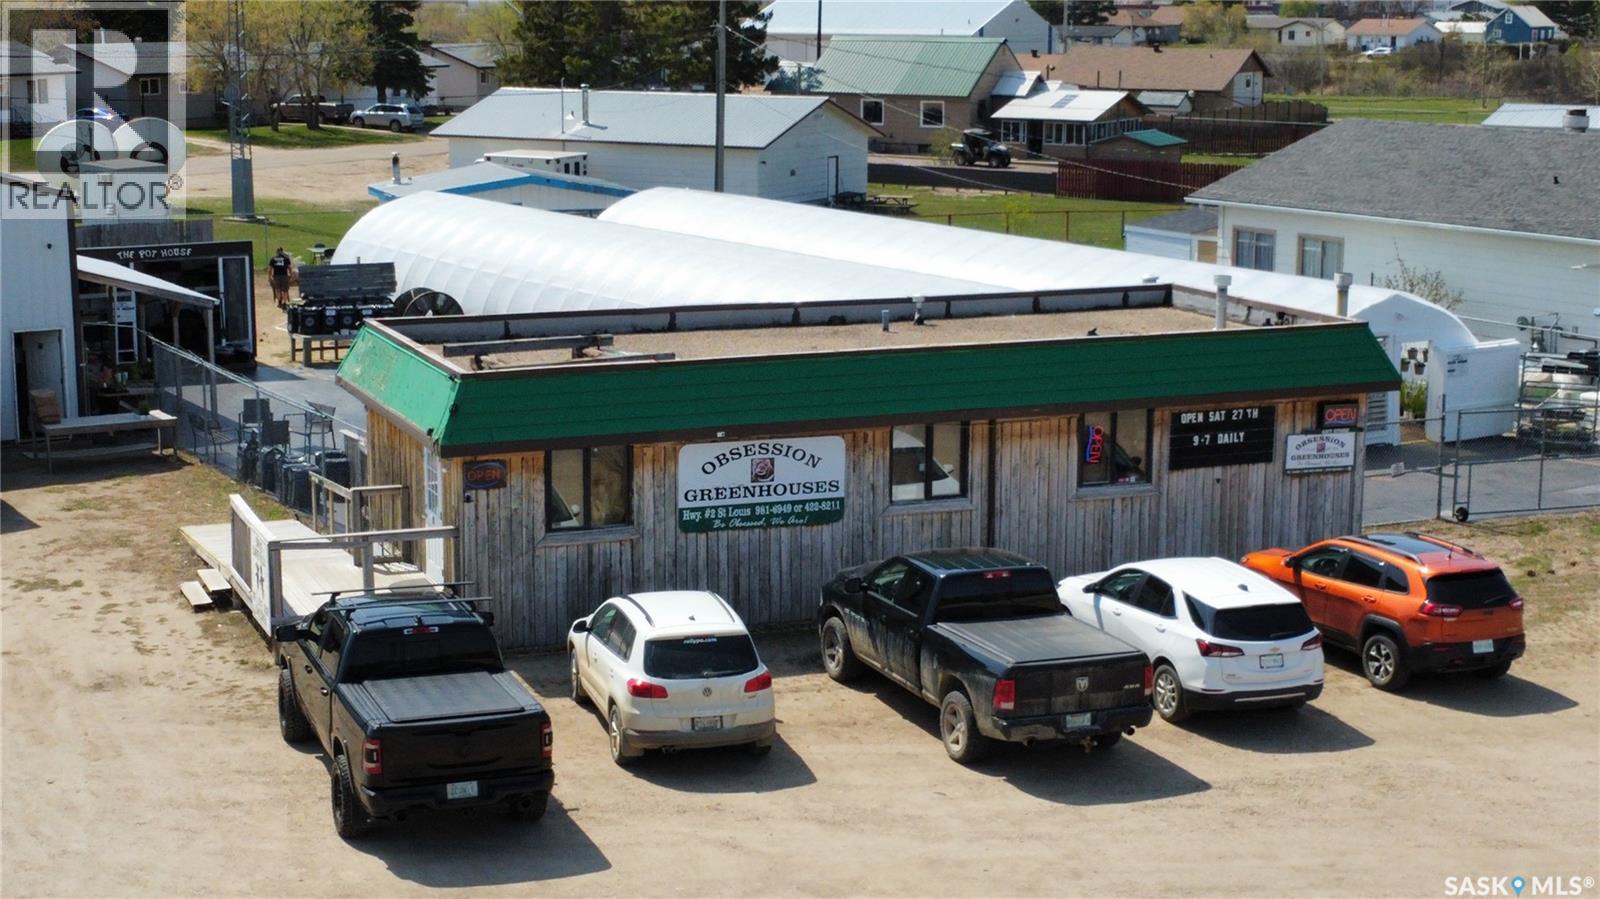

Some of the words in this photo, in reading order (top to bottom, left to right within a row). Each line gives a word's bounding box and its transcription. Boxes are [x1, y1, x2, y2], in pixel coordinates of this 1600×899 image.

[116, 250, 135, 259] THE
[139, 250, 158, 259] POT
[161, 248, 193, 257] HOUSE
[1181, 412, 1204, 424] OPEN
[1208, 410, 1227, 422] SAT
[1232, 409, 1245, 420] 27
[1325, 407, 1357, 420] OPEN
[1193, 434, 1211, 446] 9-7
[1217, 432, 1245, 444] DAILY
[701, 442, 823, 475] OBSESSION
[684, 480, 840, 502] GREENHOUSES
[793, 504, 803, 513] or
